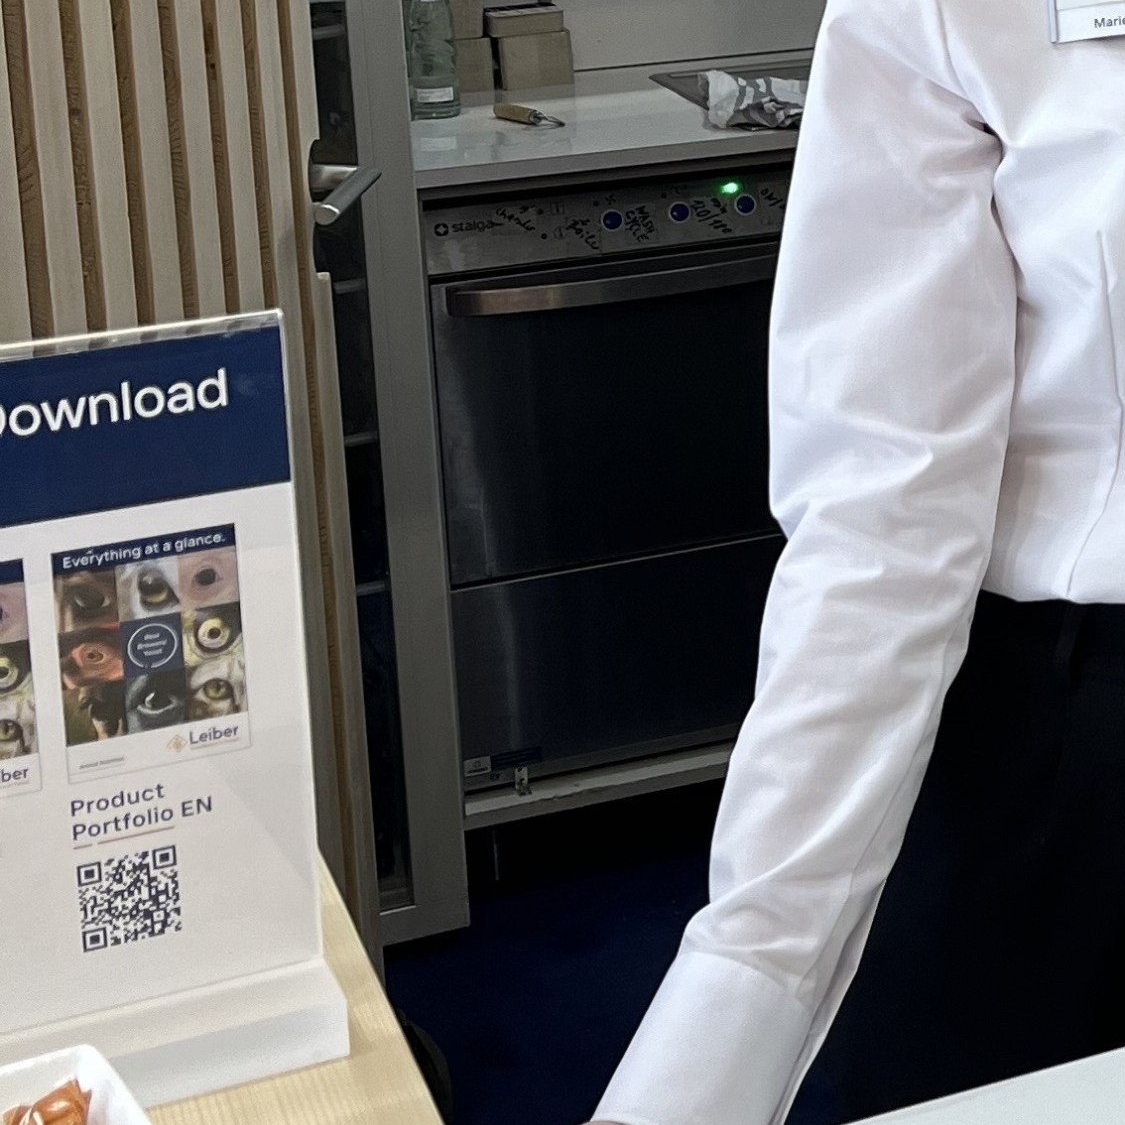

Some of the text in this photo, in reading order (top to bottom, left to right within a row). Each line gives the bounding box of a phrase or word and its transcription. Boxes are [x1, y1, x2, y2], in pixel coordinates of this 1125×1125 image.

[625, 210, 650, 242] CYCLE
[635, 205, 656, 234] WASH
[62, 532, 226, 569] Everything at a glance.
[189, 726, 239, 746] Leiber
[70, 783, 165, 817] Product
[72, 795, 213, 841] Portfolio EN
